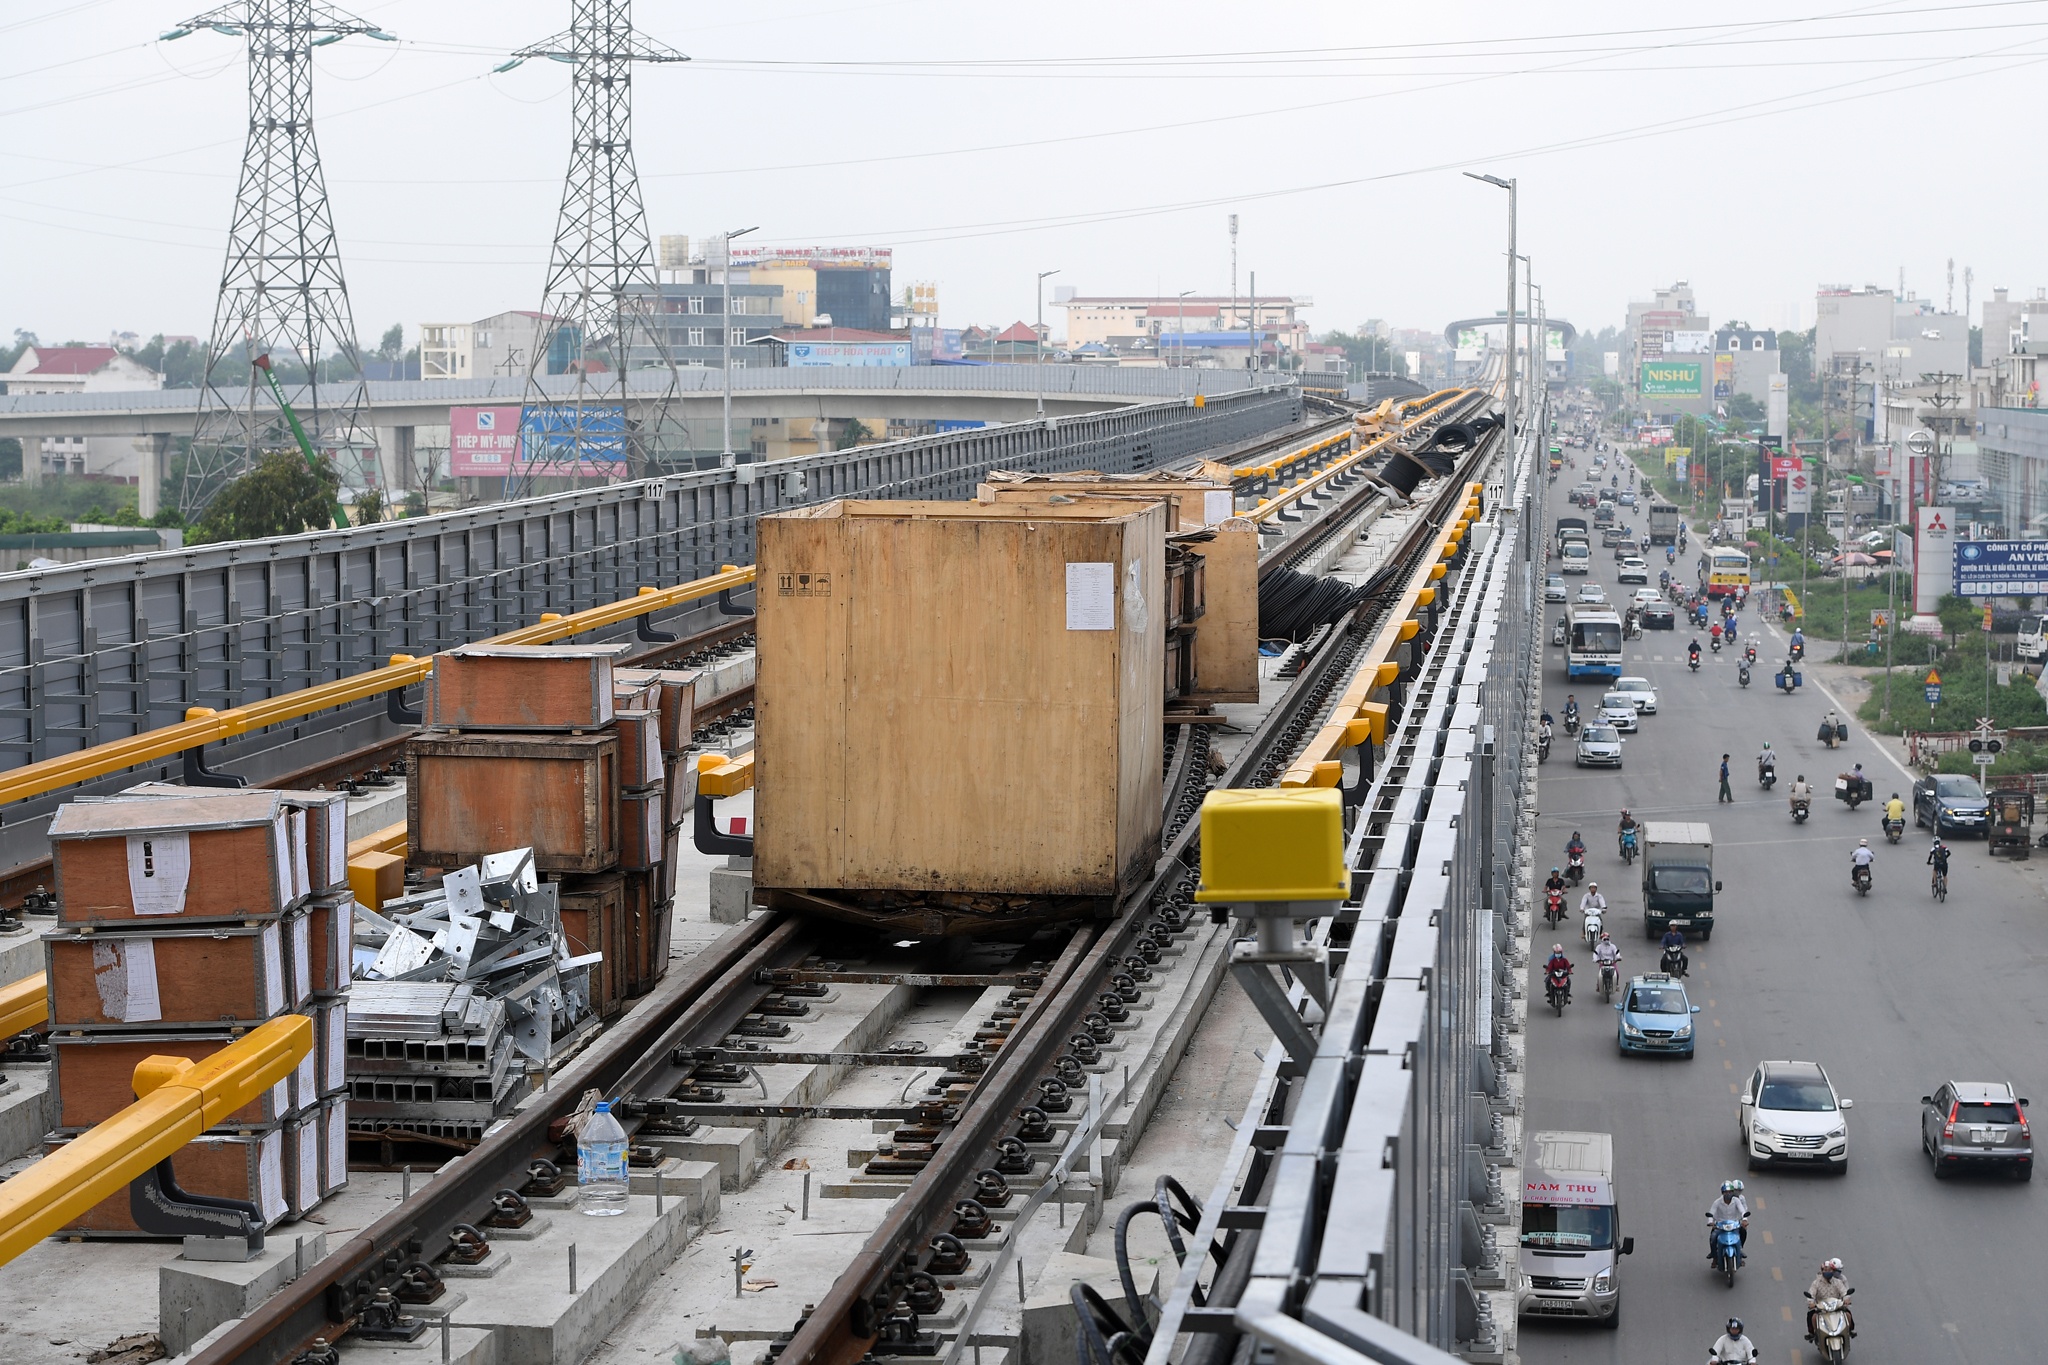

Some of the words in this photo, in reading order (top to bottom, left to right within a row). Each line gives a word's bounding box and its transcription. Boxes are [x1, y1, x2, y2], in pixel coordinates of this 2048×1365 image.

[816, 345, 840, 356] THÉP
[843, 346, 863, 356] HÒA
[866, 346, 892, 356] PHÁT
[1648, 369, 1695, 381] NISHU
[456, 433, 477, 449] THÉP
[480, 433, 516, 449] MỸ-VMS
[648, 484, 663, 497] 117
[1489, 485, 1503, 498] 117
[1987, 543, 2008, 552] CÔNG
[2021, 542, 2032, 551] CỔ
[2009, 553, 2024, 561] AN
[1566, 1185, 1597, 1193] THU
